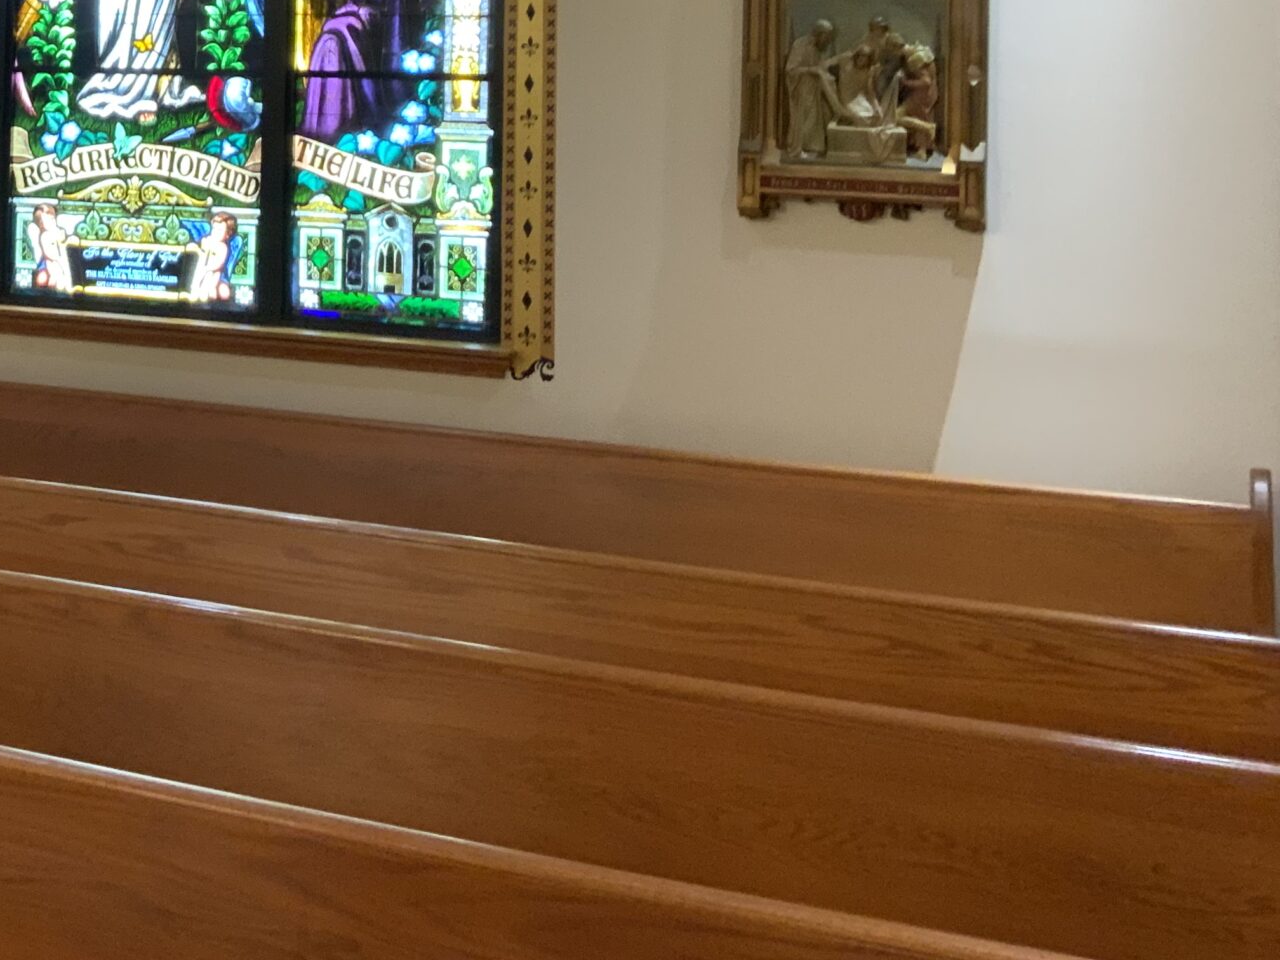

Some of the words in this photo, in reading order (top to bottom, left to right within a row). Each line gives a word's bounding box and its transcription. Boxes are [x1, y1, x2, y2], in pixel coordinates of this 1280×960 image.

[21, 145, 213, 189] RESURRECTION
[213, 160, 260, 197] AND
[295, 139, 347, 178] THE
[350, 161, 415, 200] LIFE
